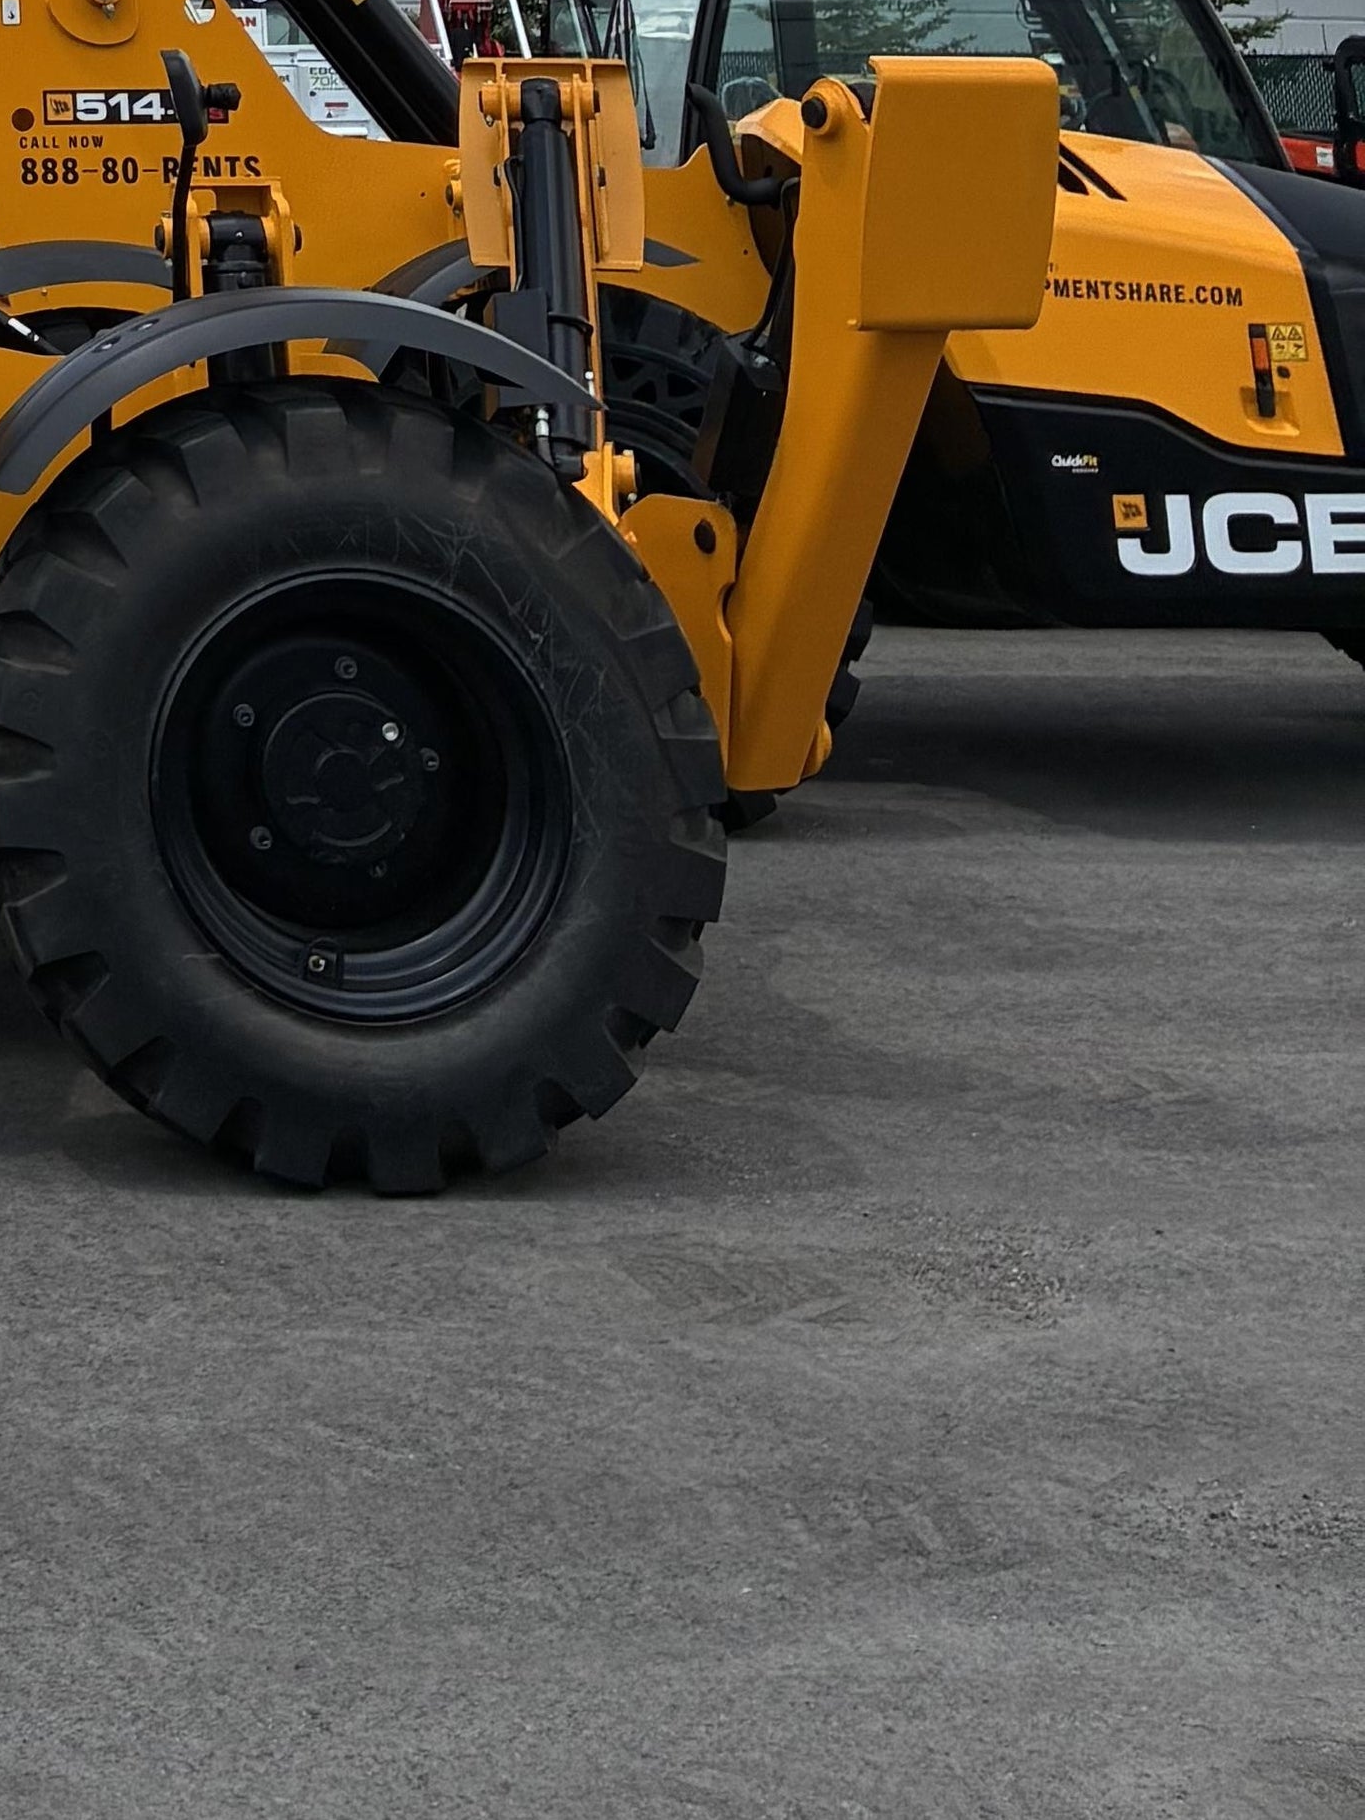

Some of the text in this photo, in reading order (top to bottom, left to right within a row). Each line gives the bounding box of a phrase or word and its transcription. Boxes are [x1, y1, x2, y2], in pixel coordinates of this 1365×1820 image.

[75, 92, 225, 122] 514-S
[19, 135, 104, 149] CALL NOW
